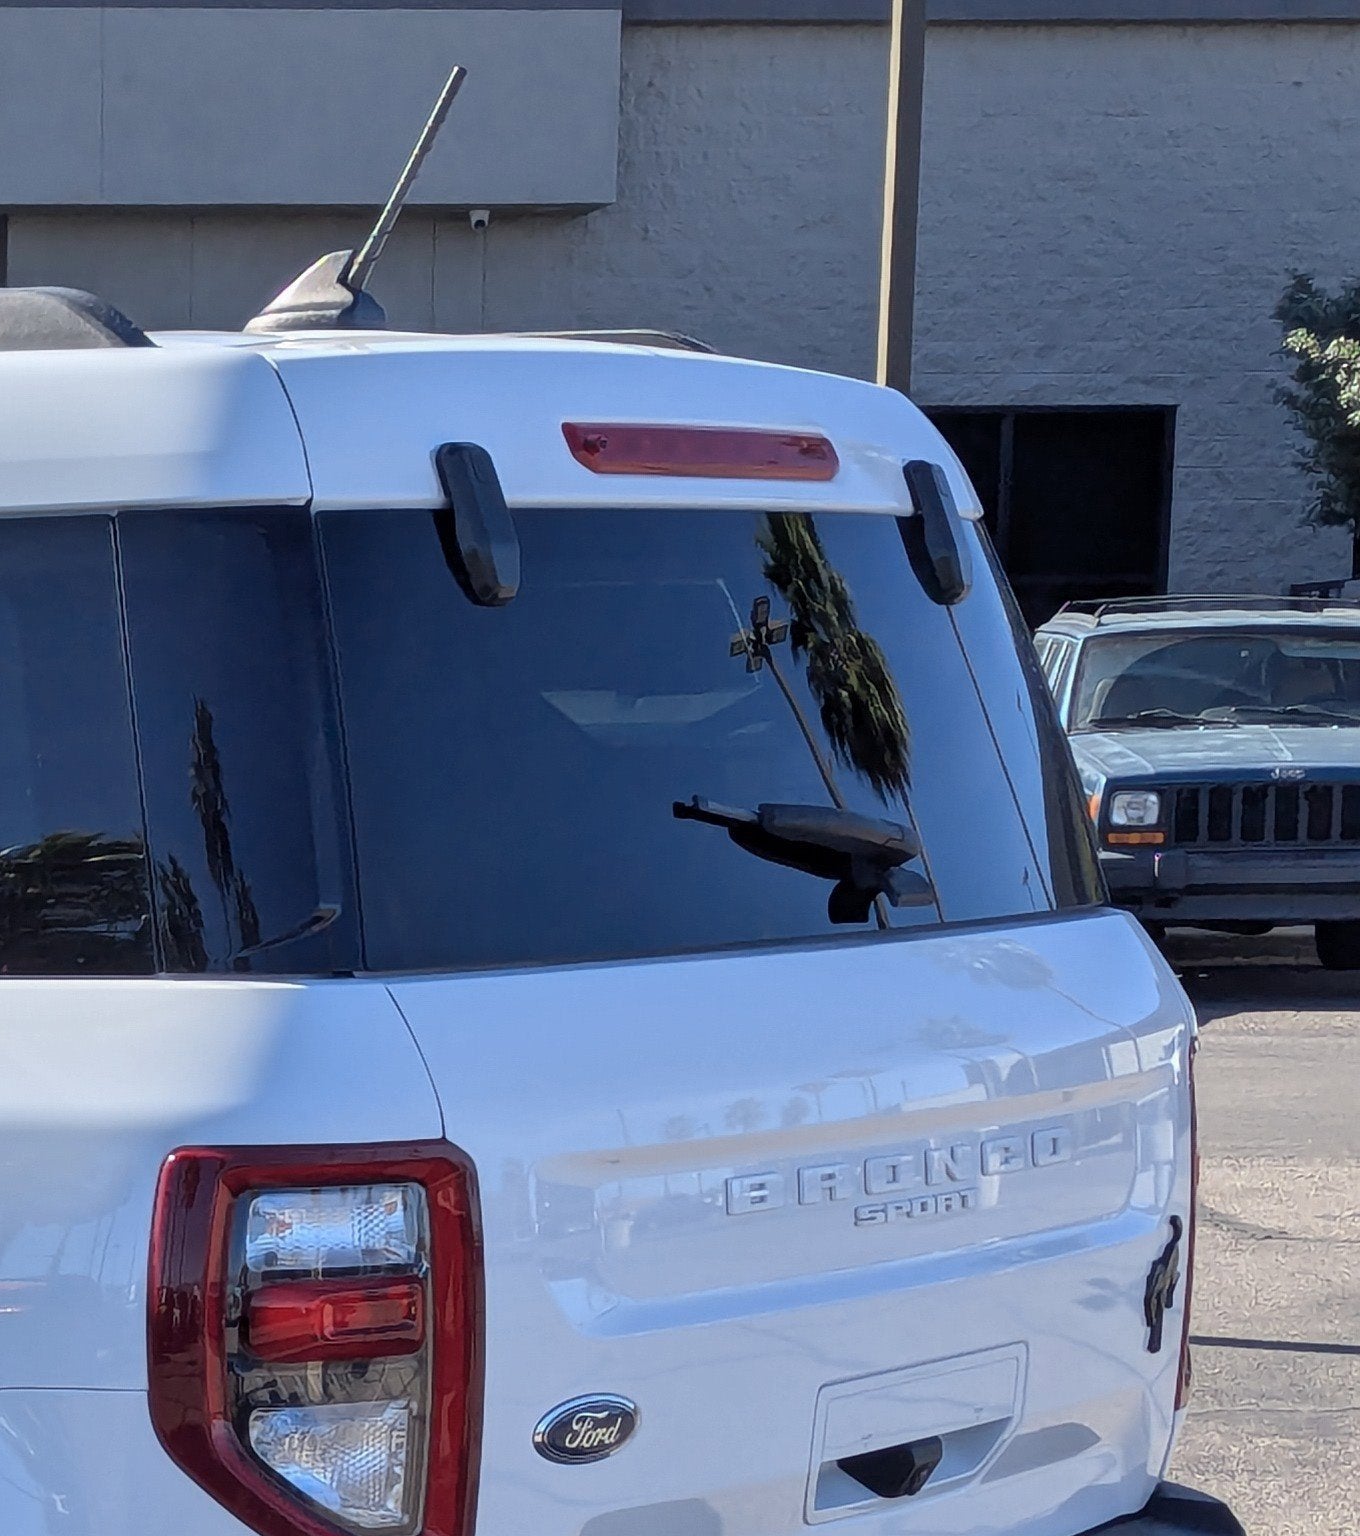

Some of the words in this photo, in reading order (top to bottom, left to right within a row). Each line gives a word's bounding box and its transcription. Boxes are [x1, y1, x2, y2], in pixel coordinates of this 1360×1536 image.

[725, 1127, 1073, 1216] BRONCO
[853, 1187, 979, 1228] SPORT
[564, 1410, 623, 1449] Ford
